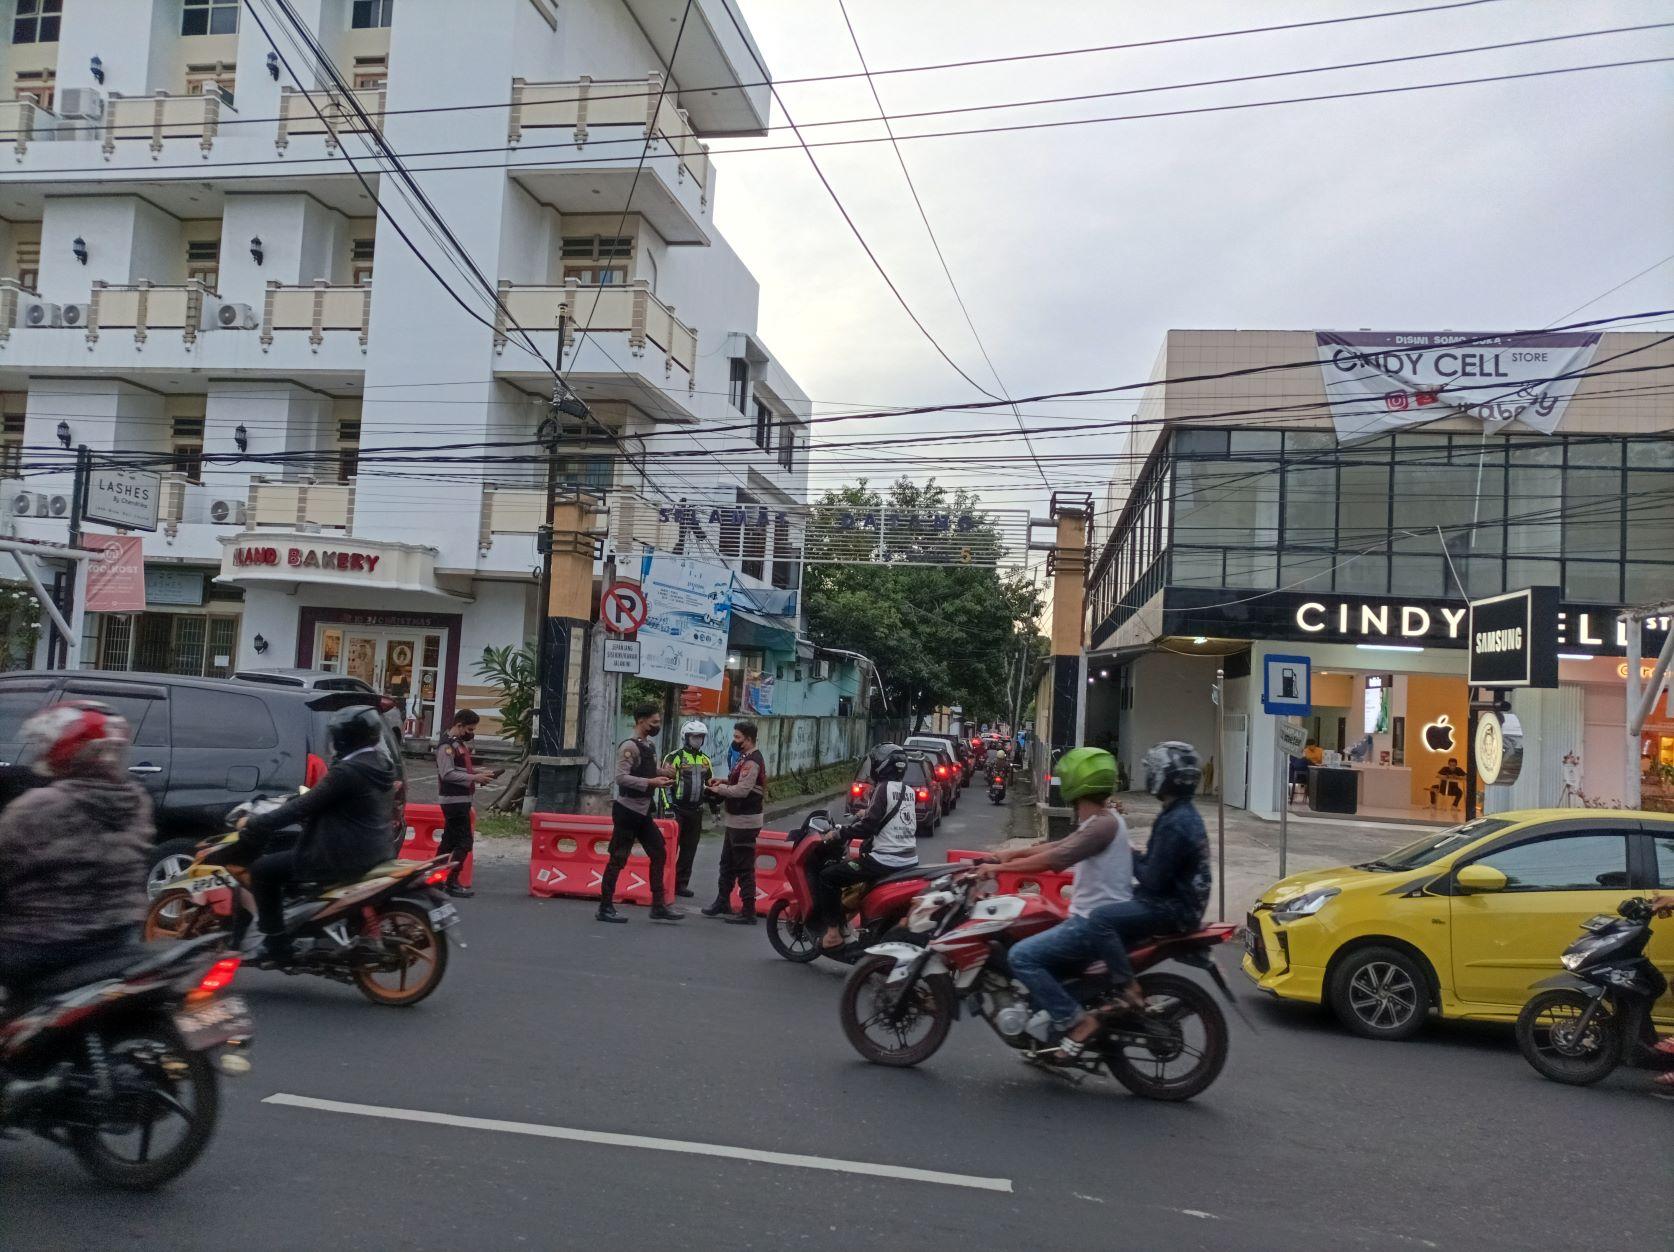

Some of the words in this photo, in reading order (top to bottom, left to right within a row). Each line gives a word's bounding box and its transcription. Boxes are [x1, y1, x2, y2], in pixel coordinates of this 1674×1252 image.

[1433, 352, 1509, 378] CELL
[1511, 352, 1549, 363] STORE
[99, 478, 150, 501] LASHES
[287, 547, 381, 573] BAKERY
[1295, 601, 1467, 639] CINDY
[1475, 626, 1523, 655] SAMSUNG
